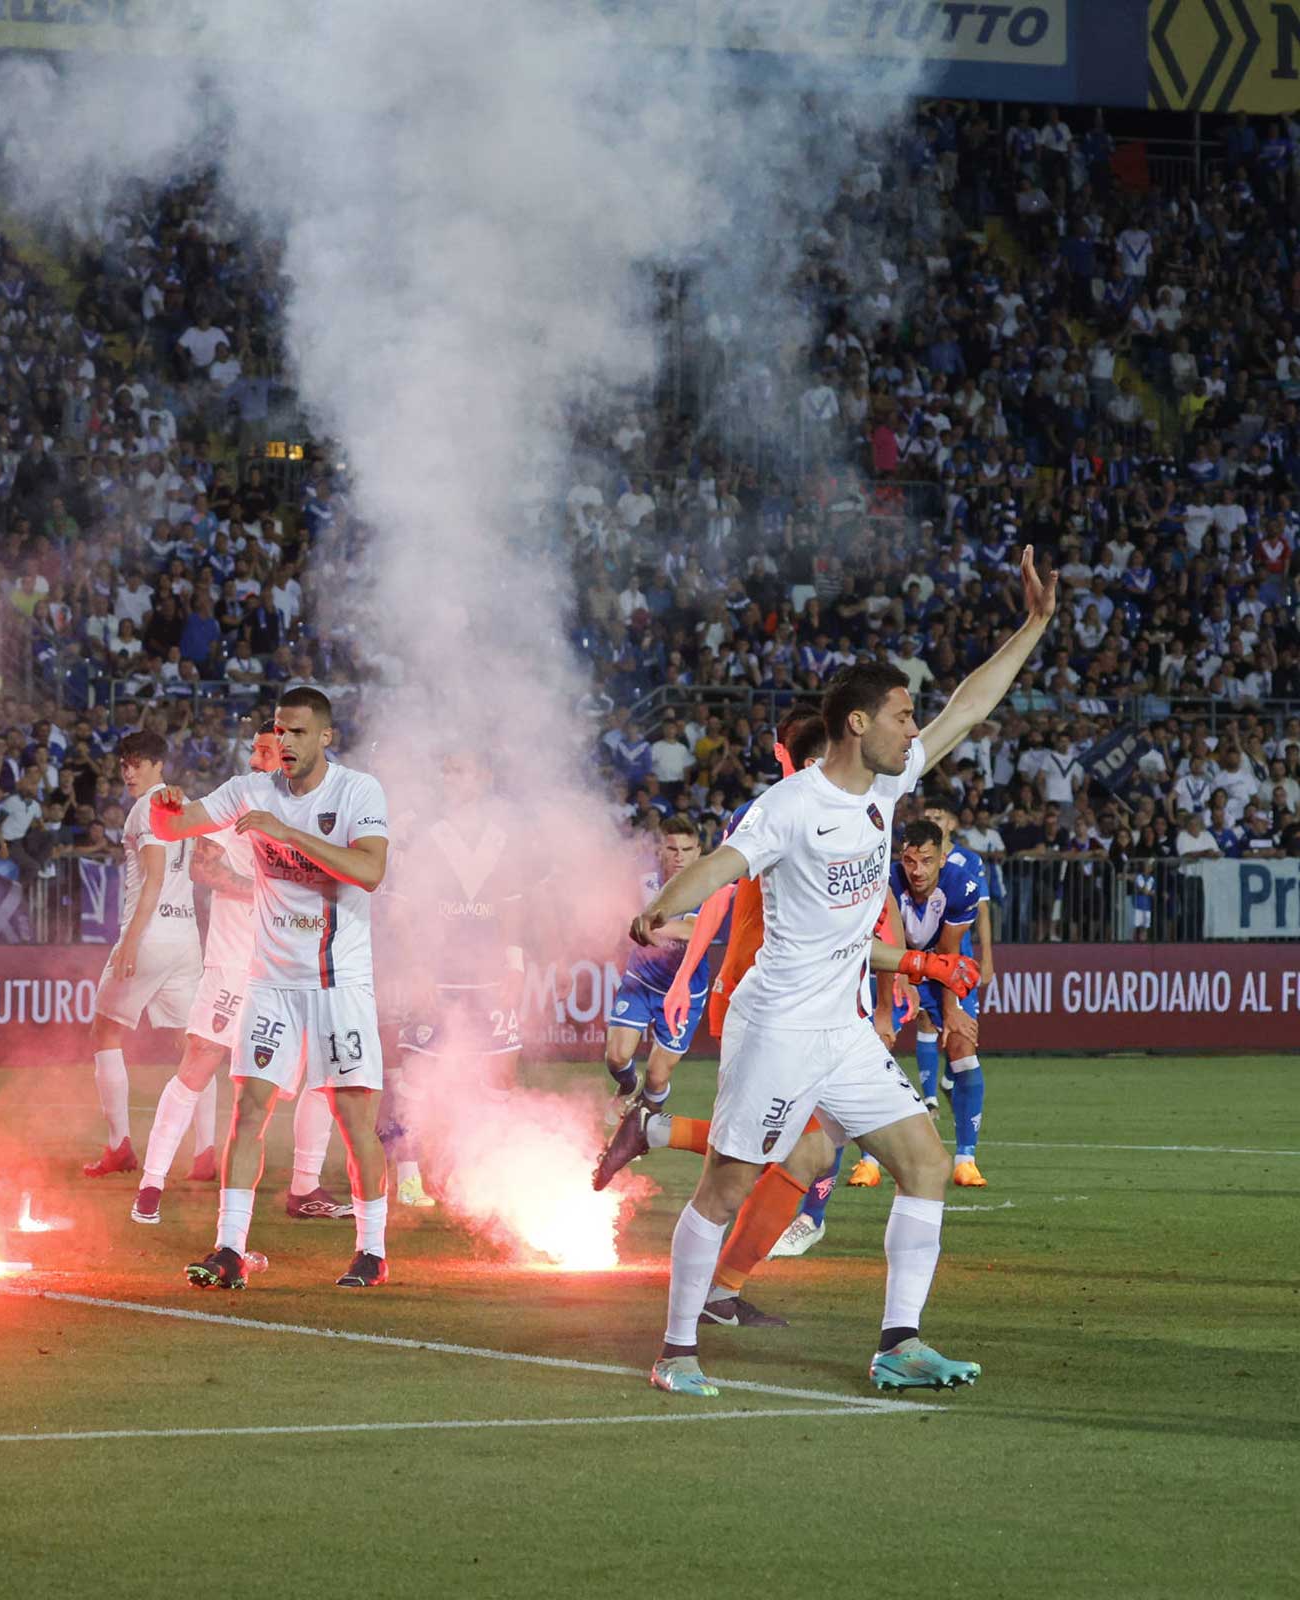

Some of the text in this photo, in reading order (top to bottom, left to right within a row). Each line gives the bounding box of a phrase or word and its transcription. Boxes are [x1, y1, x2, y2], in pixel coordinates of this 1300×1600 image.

[1238, 863, 1300, 929] Pr
[214, 988, 243, 1009] 3F
[1063, 971, 1232, 1013] GUARDIAMO
[1240, 971, 1272, 1013] AL
[253, 1015, 286, 1038] 3F
[490, 1008, 519, 1037] 24
[328, 1031, 363, 1063] 13
